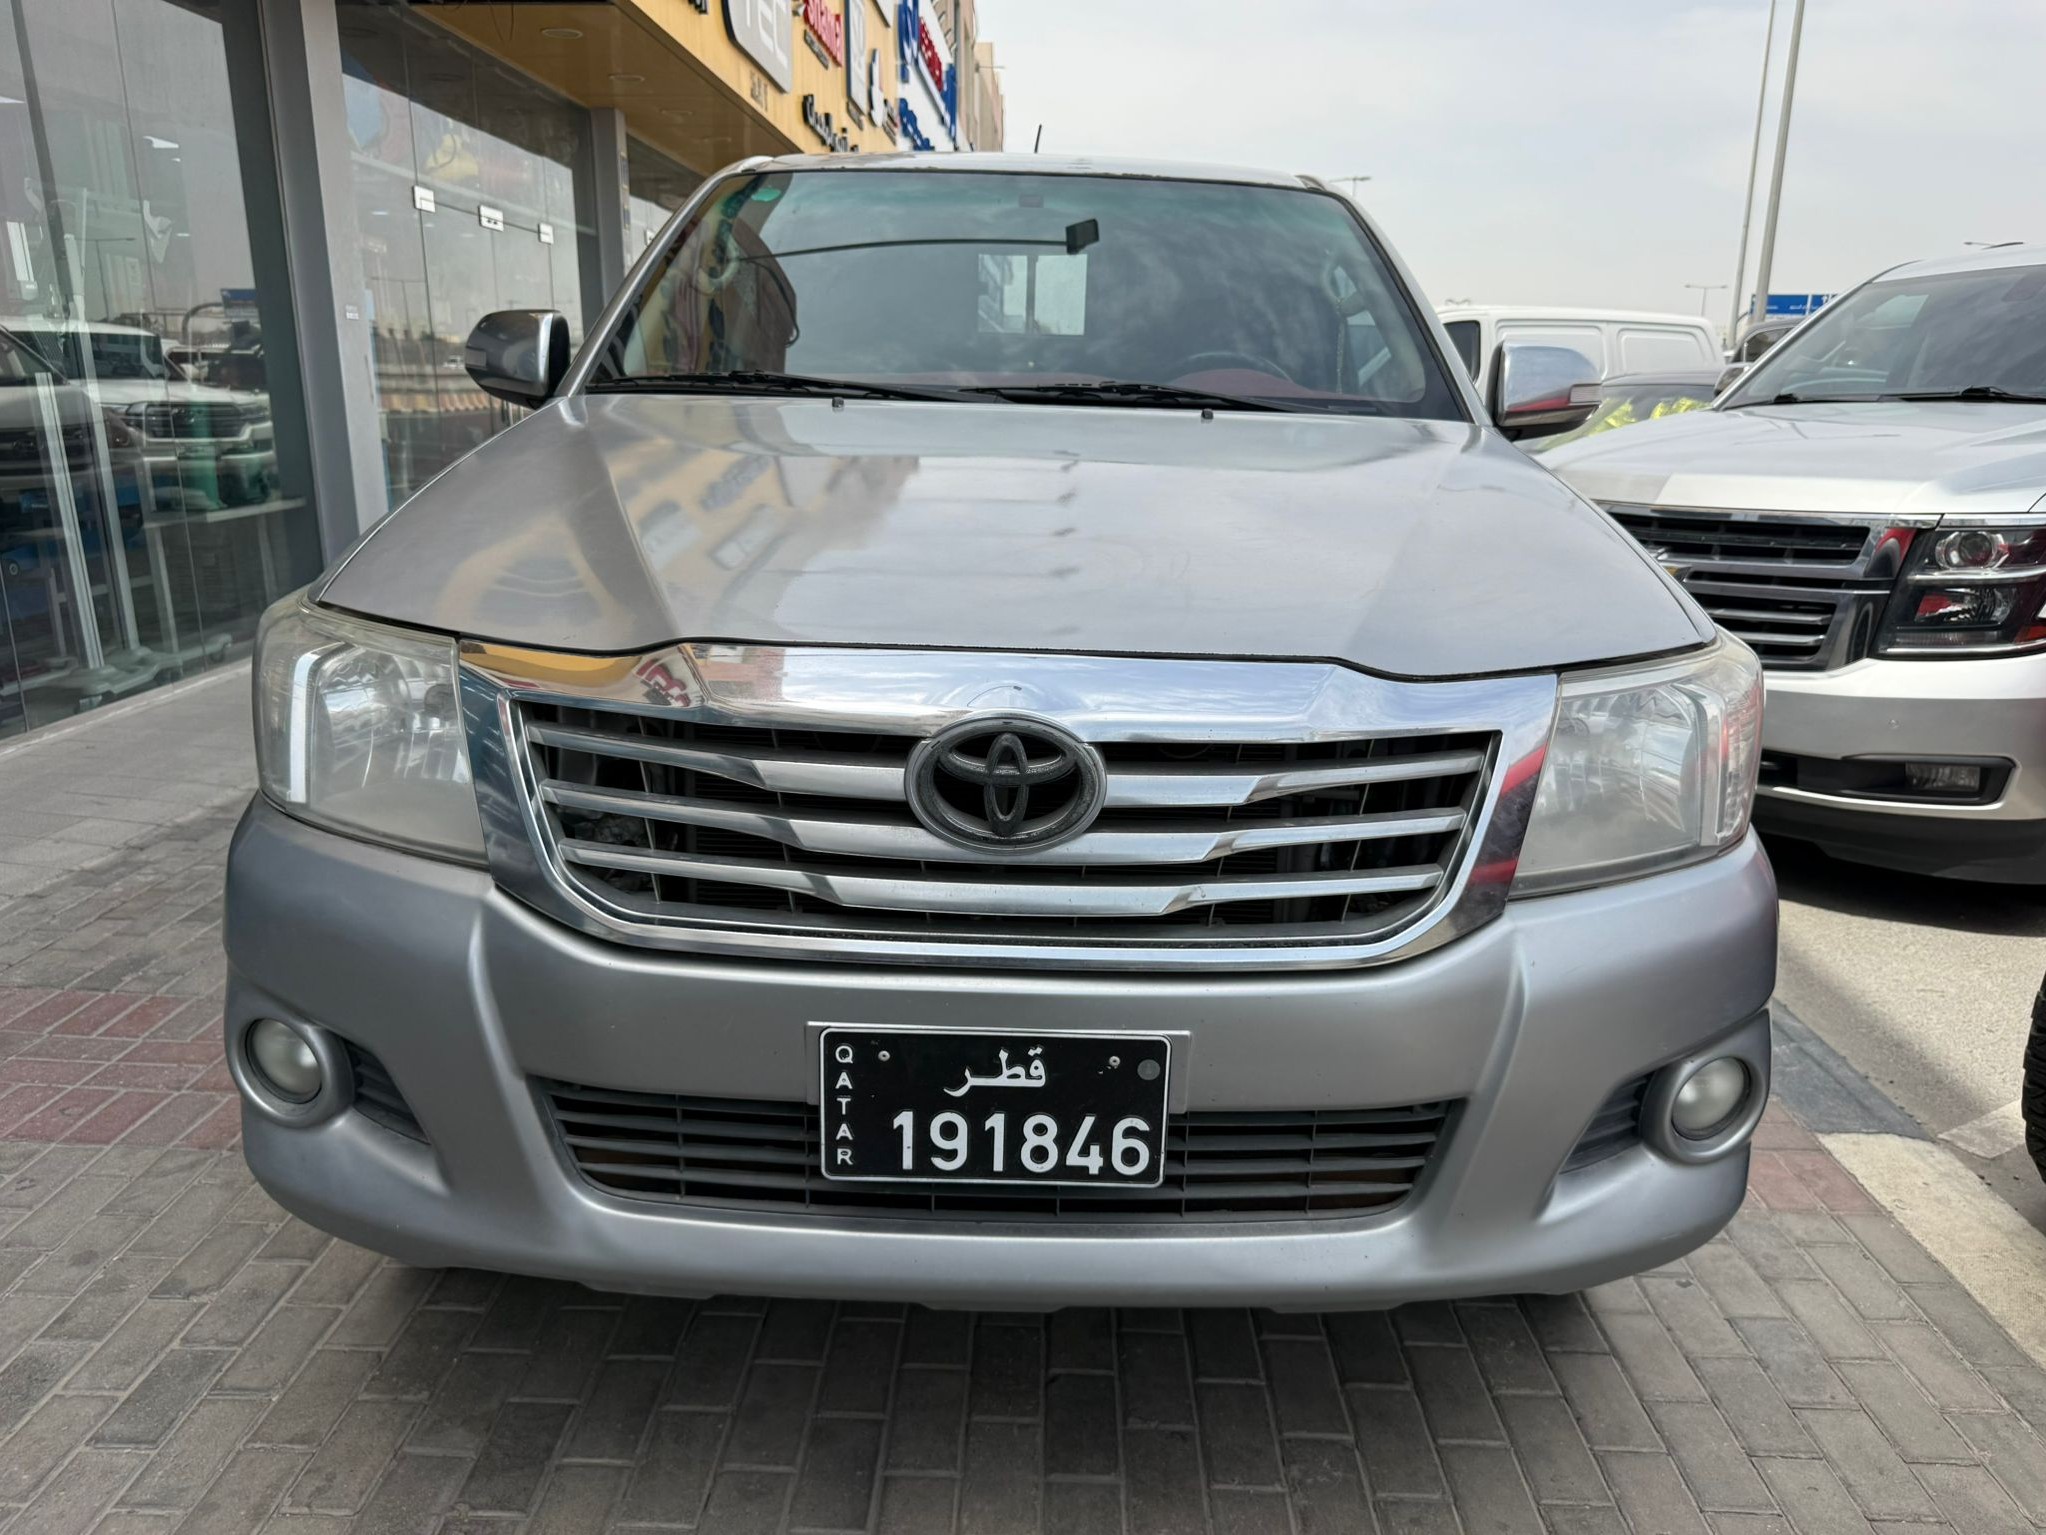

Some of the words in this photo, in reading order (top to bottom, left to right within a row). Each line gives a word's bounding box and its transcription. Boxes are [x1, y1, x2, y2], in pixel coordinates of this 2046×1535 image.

[943, 1047, 1047, 1097] قطر
[834, 1045, 854, 1165] QATAR
[892, 1110, 1150, 1175] 191846
